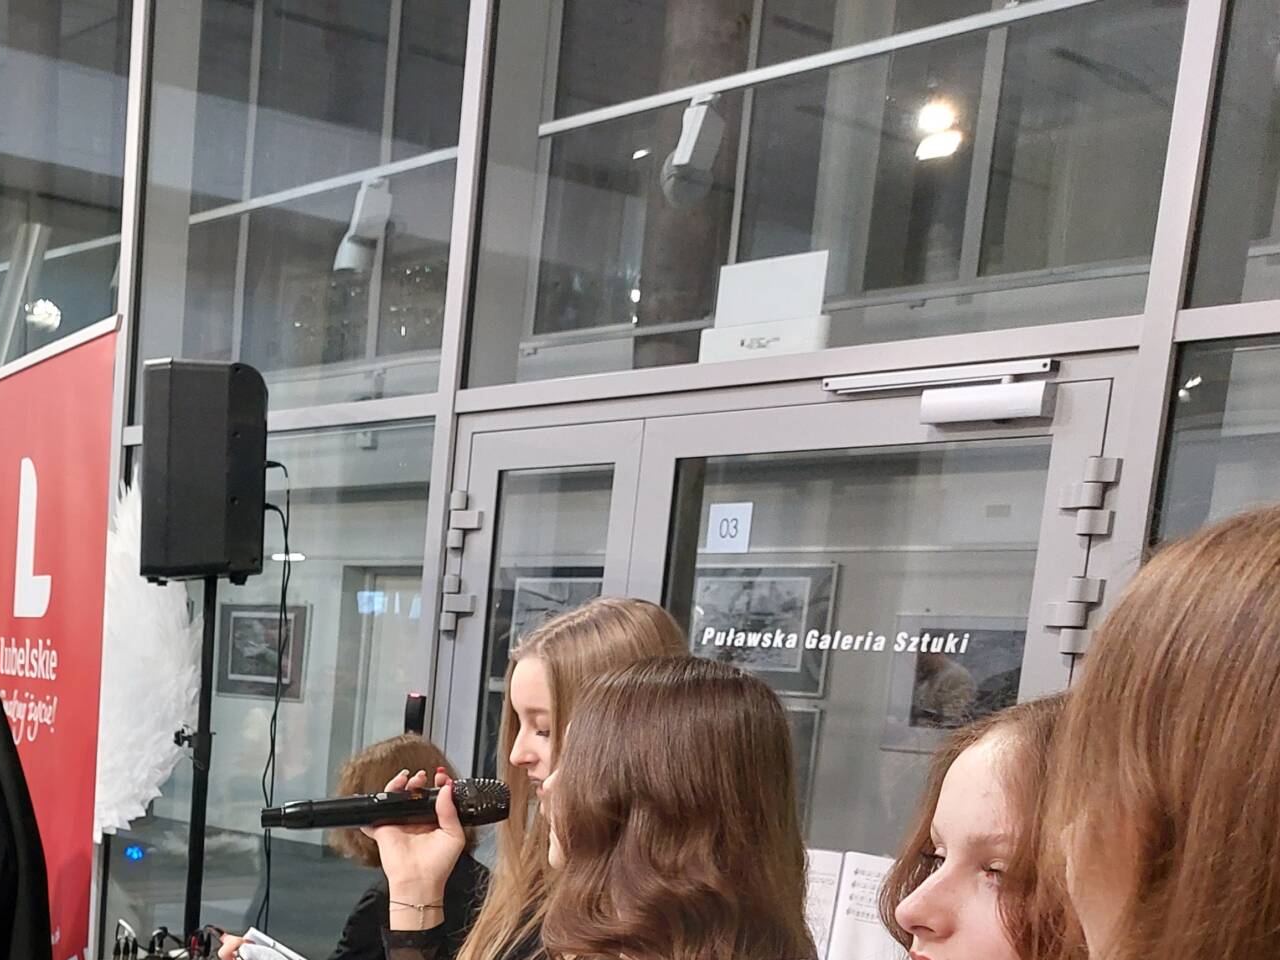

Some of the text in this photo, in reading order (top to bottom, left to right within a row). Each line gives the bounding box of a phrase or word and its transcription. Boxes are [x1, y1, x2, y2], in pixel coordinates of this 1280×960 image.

[13, 456, 52, 618] L
[719, 518, 739, 539] 03
[700, 626, 971, 654] Puławska Galeria Sztuki
